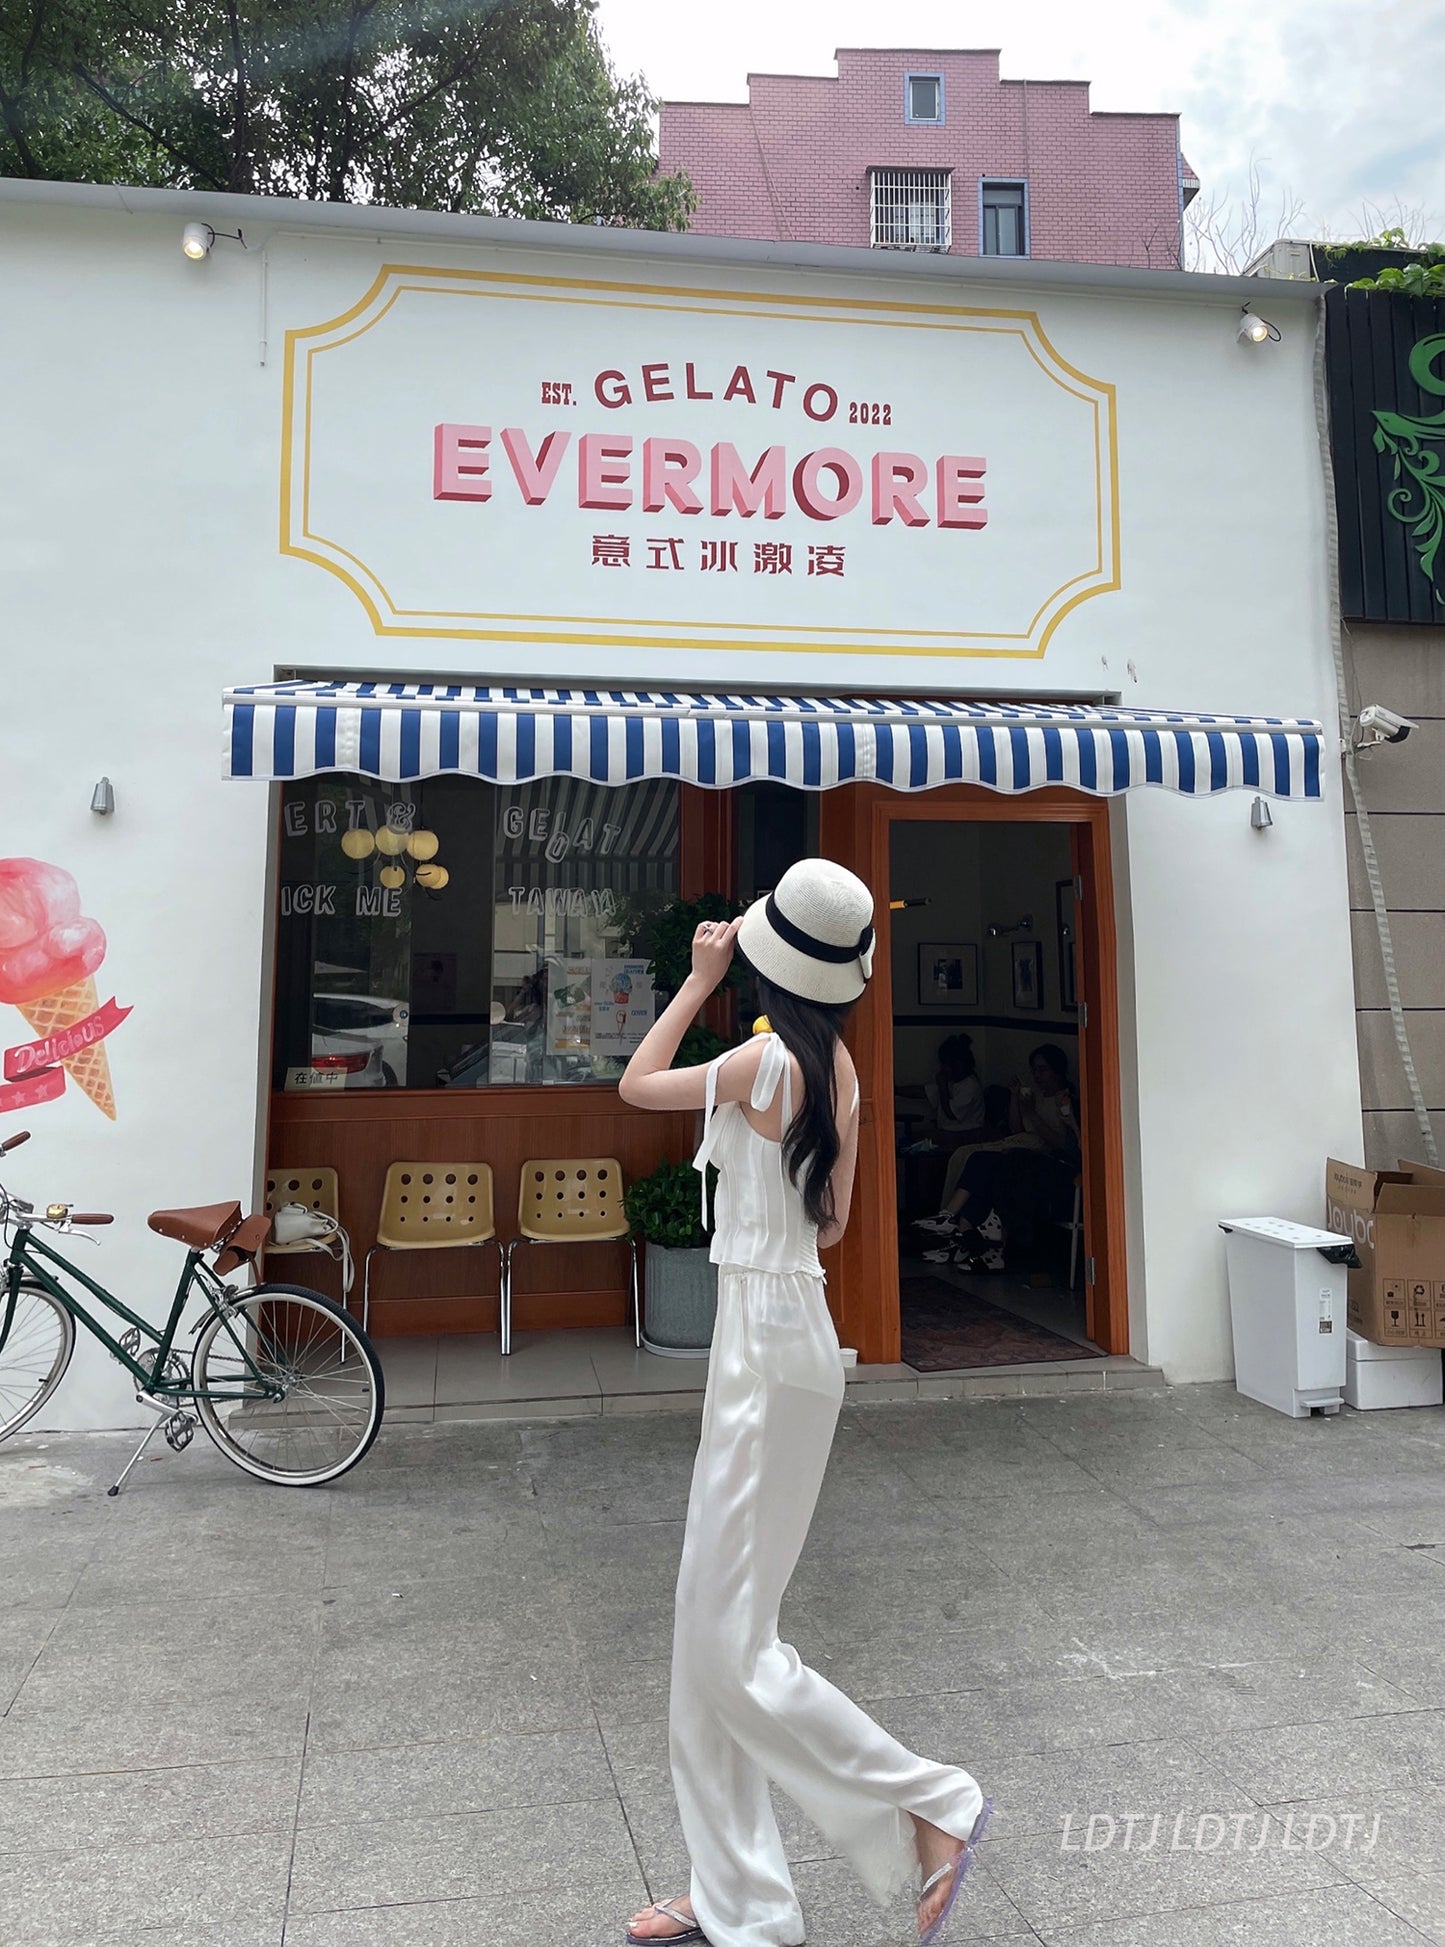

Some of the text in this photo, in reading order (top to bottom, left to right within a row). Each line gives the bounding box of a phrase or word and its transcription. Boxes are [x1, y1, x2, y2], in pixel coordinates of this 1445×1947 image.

[541, 362, 892, 425] EST. GELATO 2022
[434, 423, 988, 530] EVERMORE
[591, 534, 846, 577] 意式冰激凌
[355, 885, 403, 917] ME
[14, 1015, 105, 1073] Delicious
